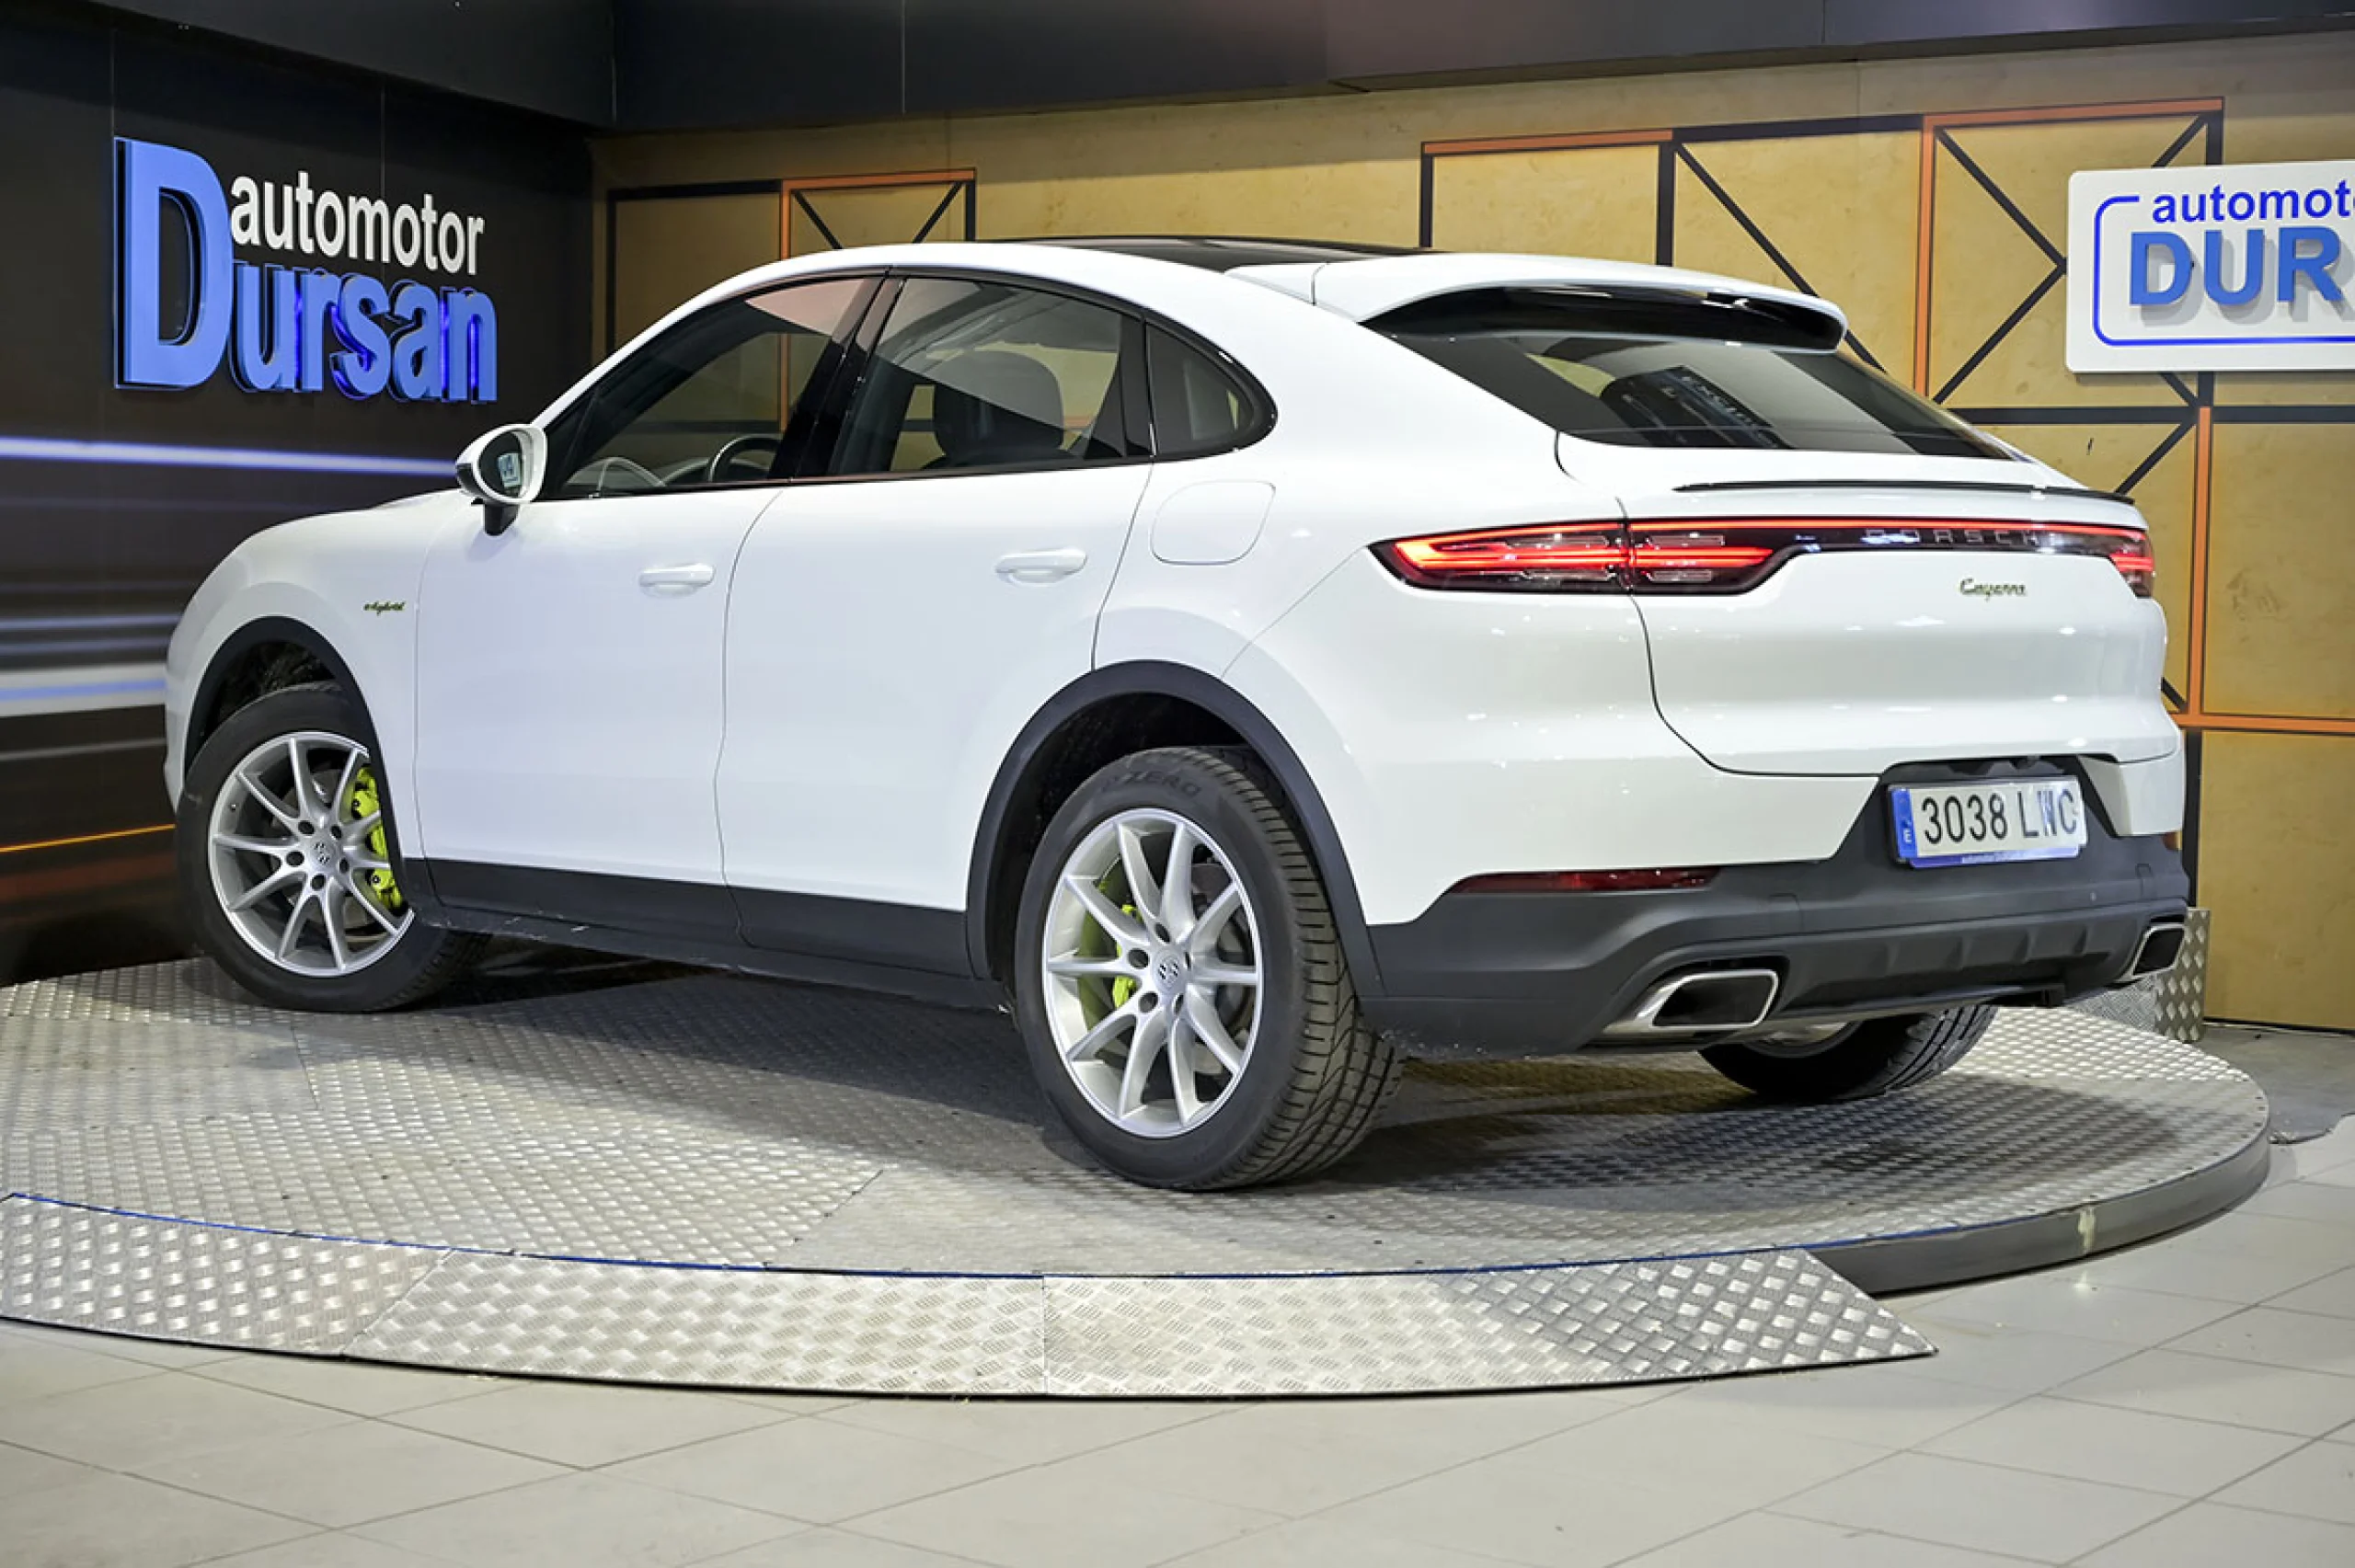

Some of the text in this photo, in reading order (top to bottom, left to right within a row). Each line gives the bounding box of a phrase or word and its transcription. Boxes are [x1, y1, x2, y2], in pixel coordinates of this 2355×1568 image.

[230, 171, 485, 275] automotor
[2152, 179, 2355, 223] automot
[113, 136, 498, 403] Dursan
[2129, 225, 2344, 306] DUR
[1922, 793, 2008, 845] 3038
